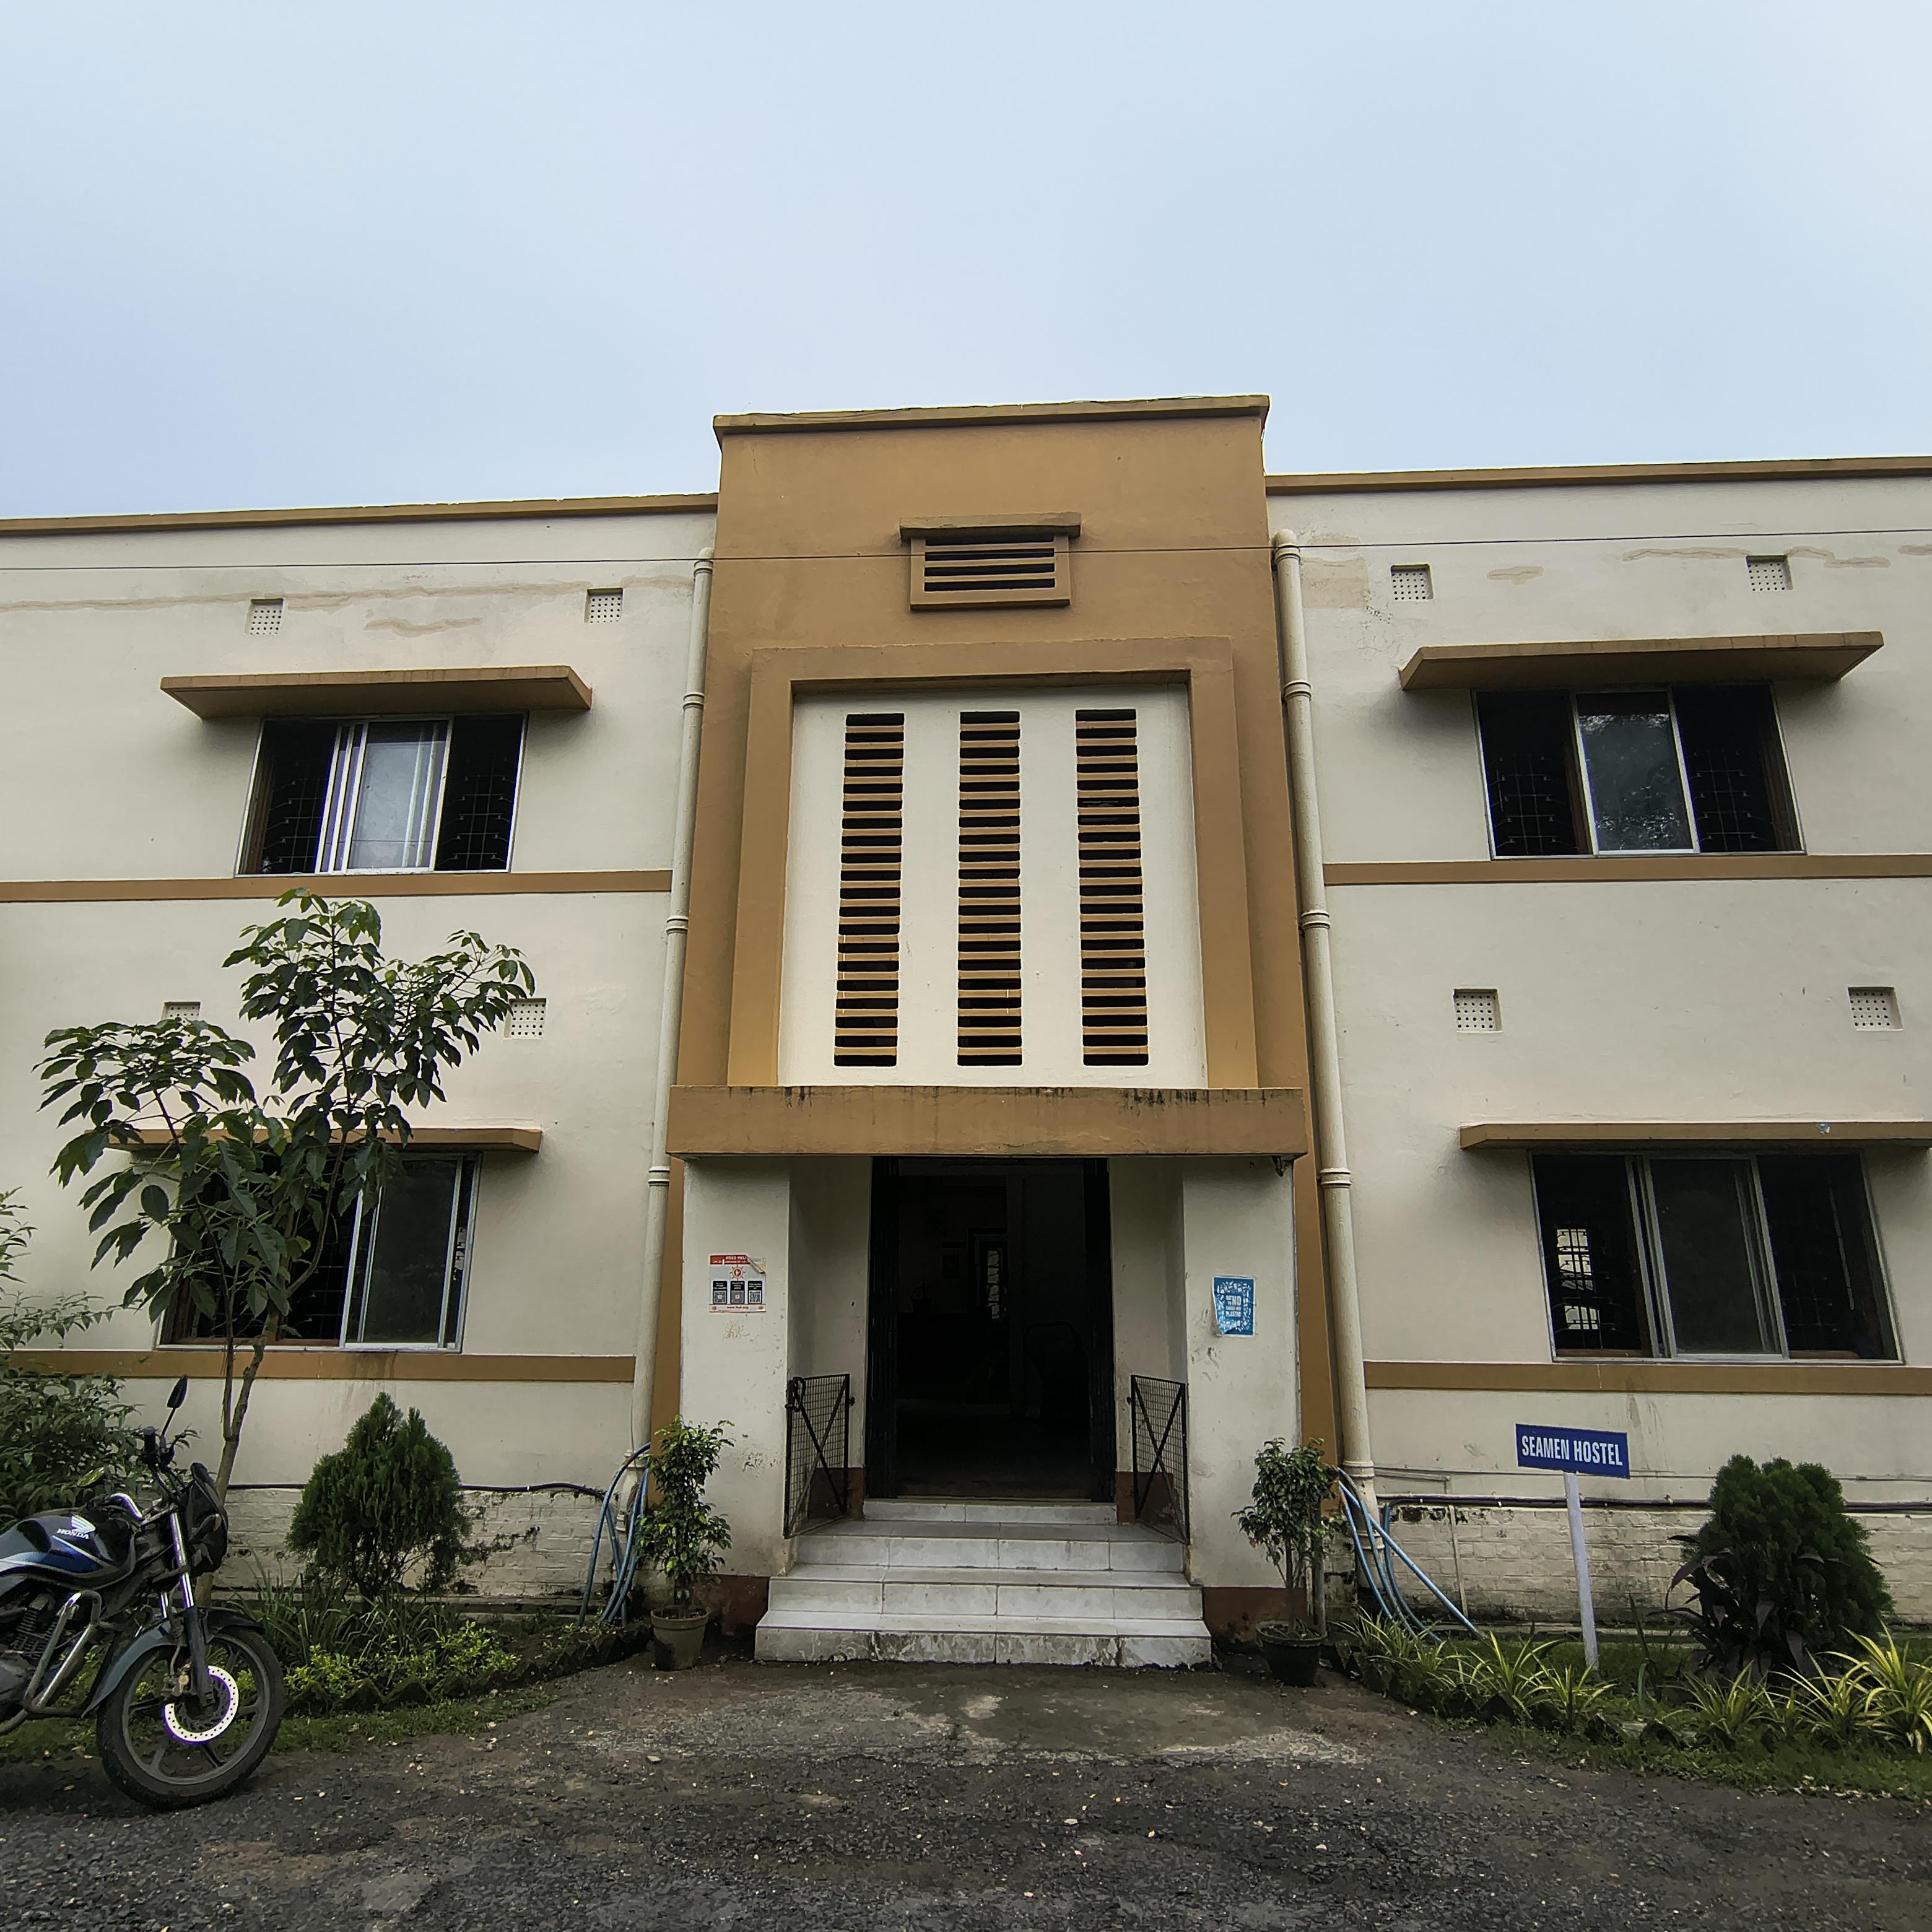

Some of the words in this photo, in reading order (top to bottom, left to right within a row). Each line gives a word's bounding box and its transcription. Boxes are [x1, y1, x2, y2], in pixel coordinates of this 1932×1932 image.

[1232, 1295, 1242, 1305] NO
[1521, 1435, 1570, 1461] SEAMEN
[1573, 1440, 1623, 1466] HOSTEL
[56, 1528, 90, 1539] HONDA
